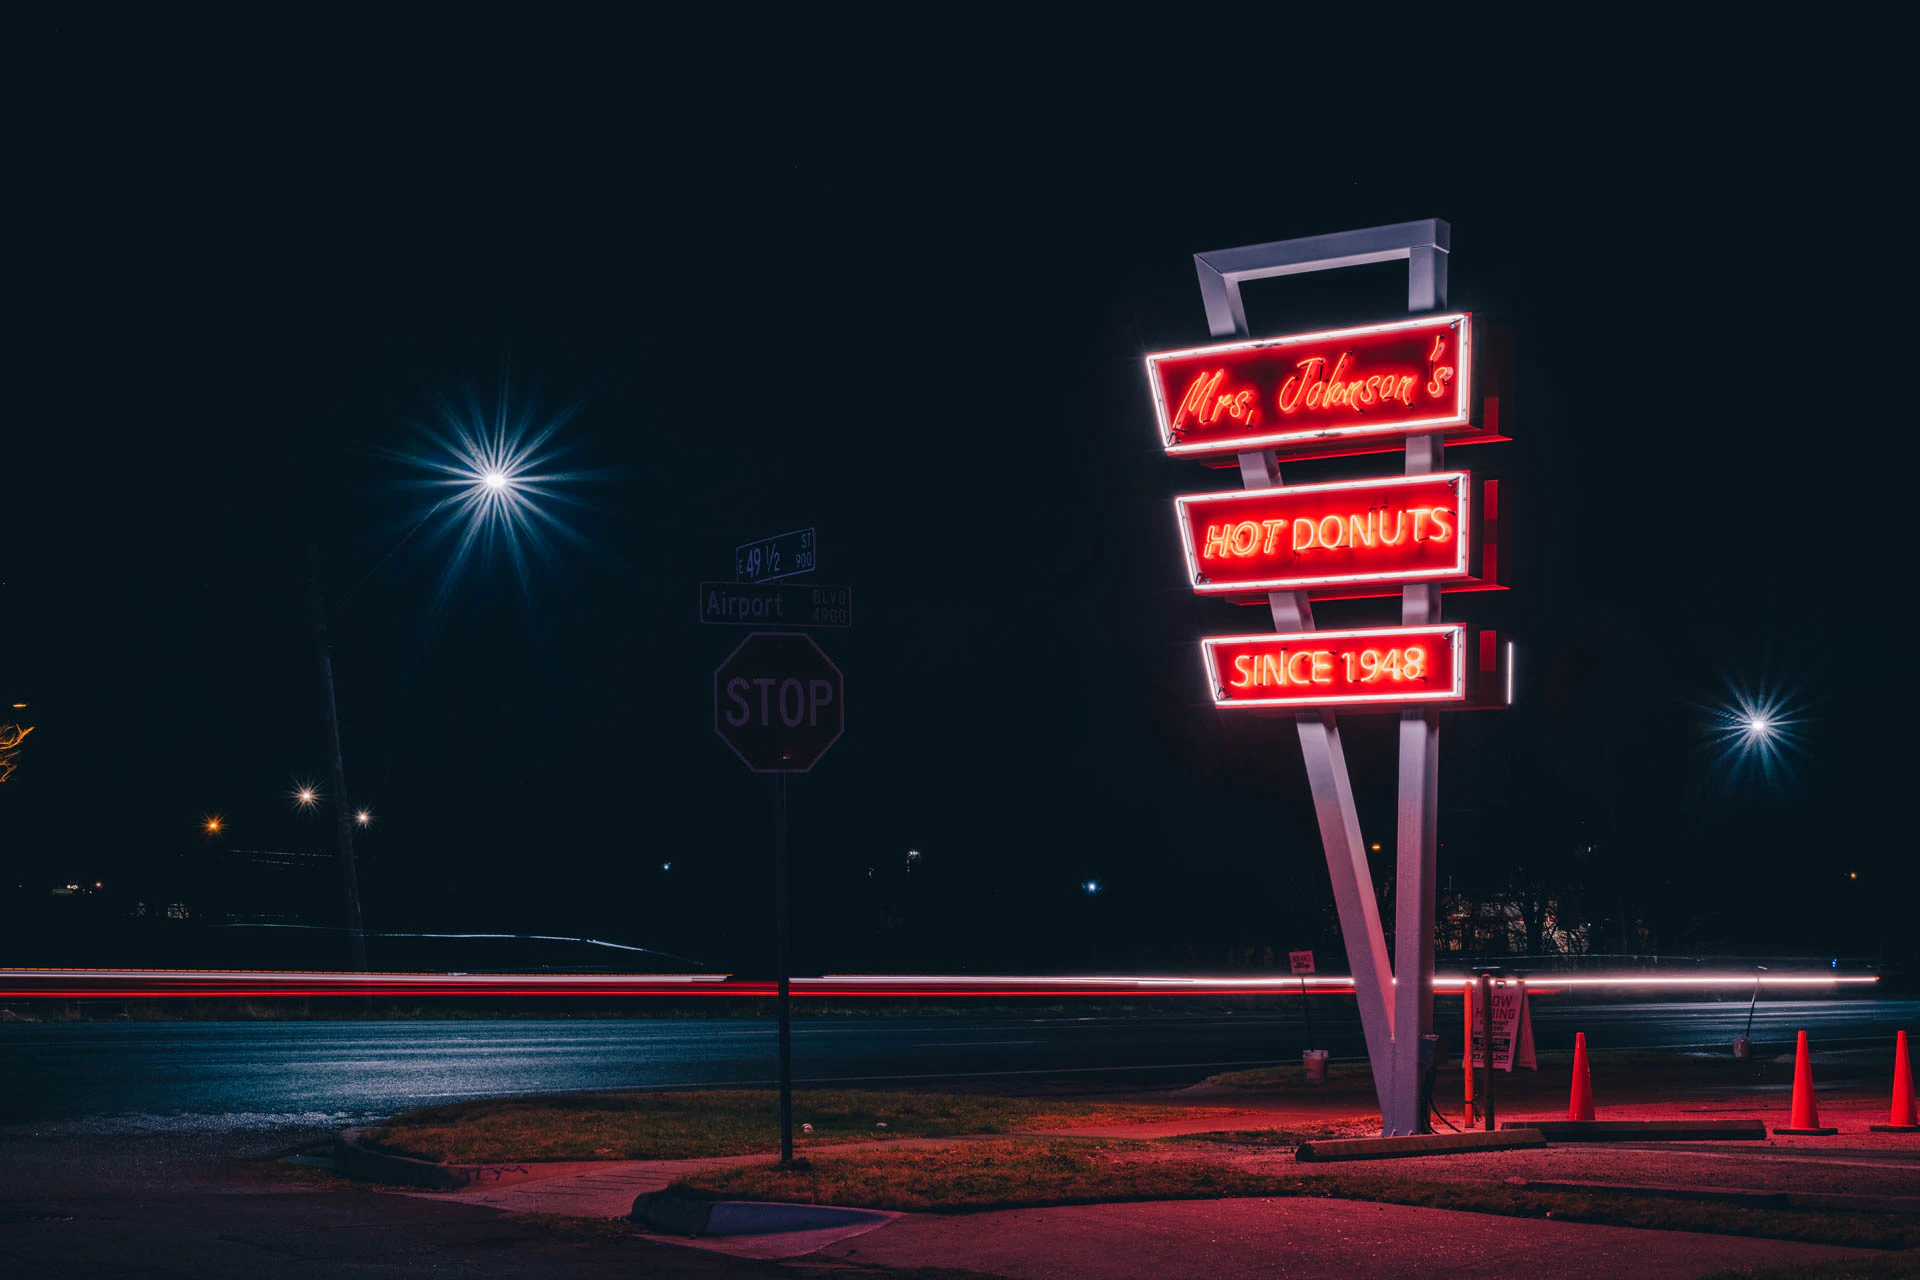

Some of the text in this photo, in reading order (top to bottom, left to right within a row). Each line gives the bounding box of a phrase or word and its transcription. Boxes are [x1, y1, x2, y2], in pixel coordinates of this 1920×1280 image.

[1278, 334, 1454, 414] Johnson's
[801, 531, 812, 549] ST
[1203, 506, 1453, 559] HOT DONUTS
[737, 559, 745, 575] E
[745, 547, 761, 578] 49
[796, 551, 813, 568] 900
[706, 590, 784, 620] Airport
[811, 589, 847, 605] BLVD
[811, 608, 847, 625] 4900
[1229, 646, 1425, 687] SINCE 1948
[724, 677, 834, 728] STOP
